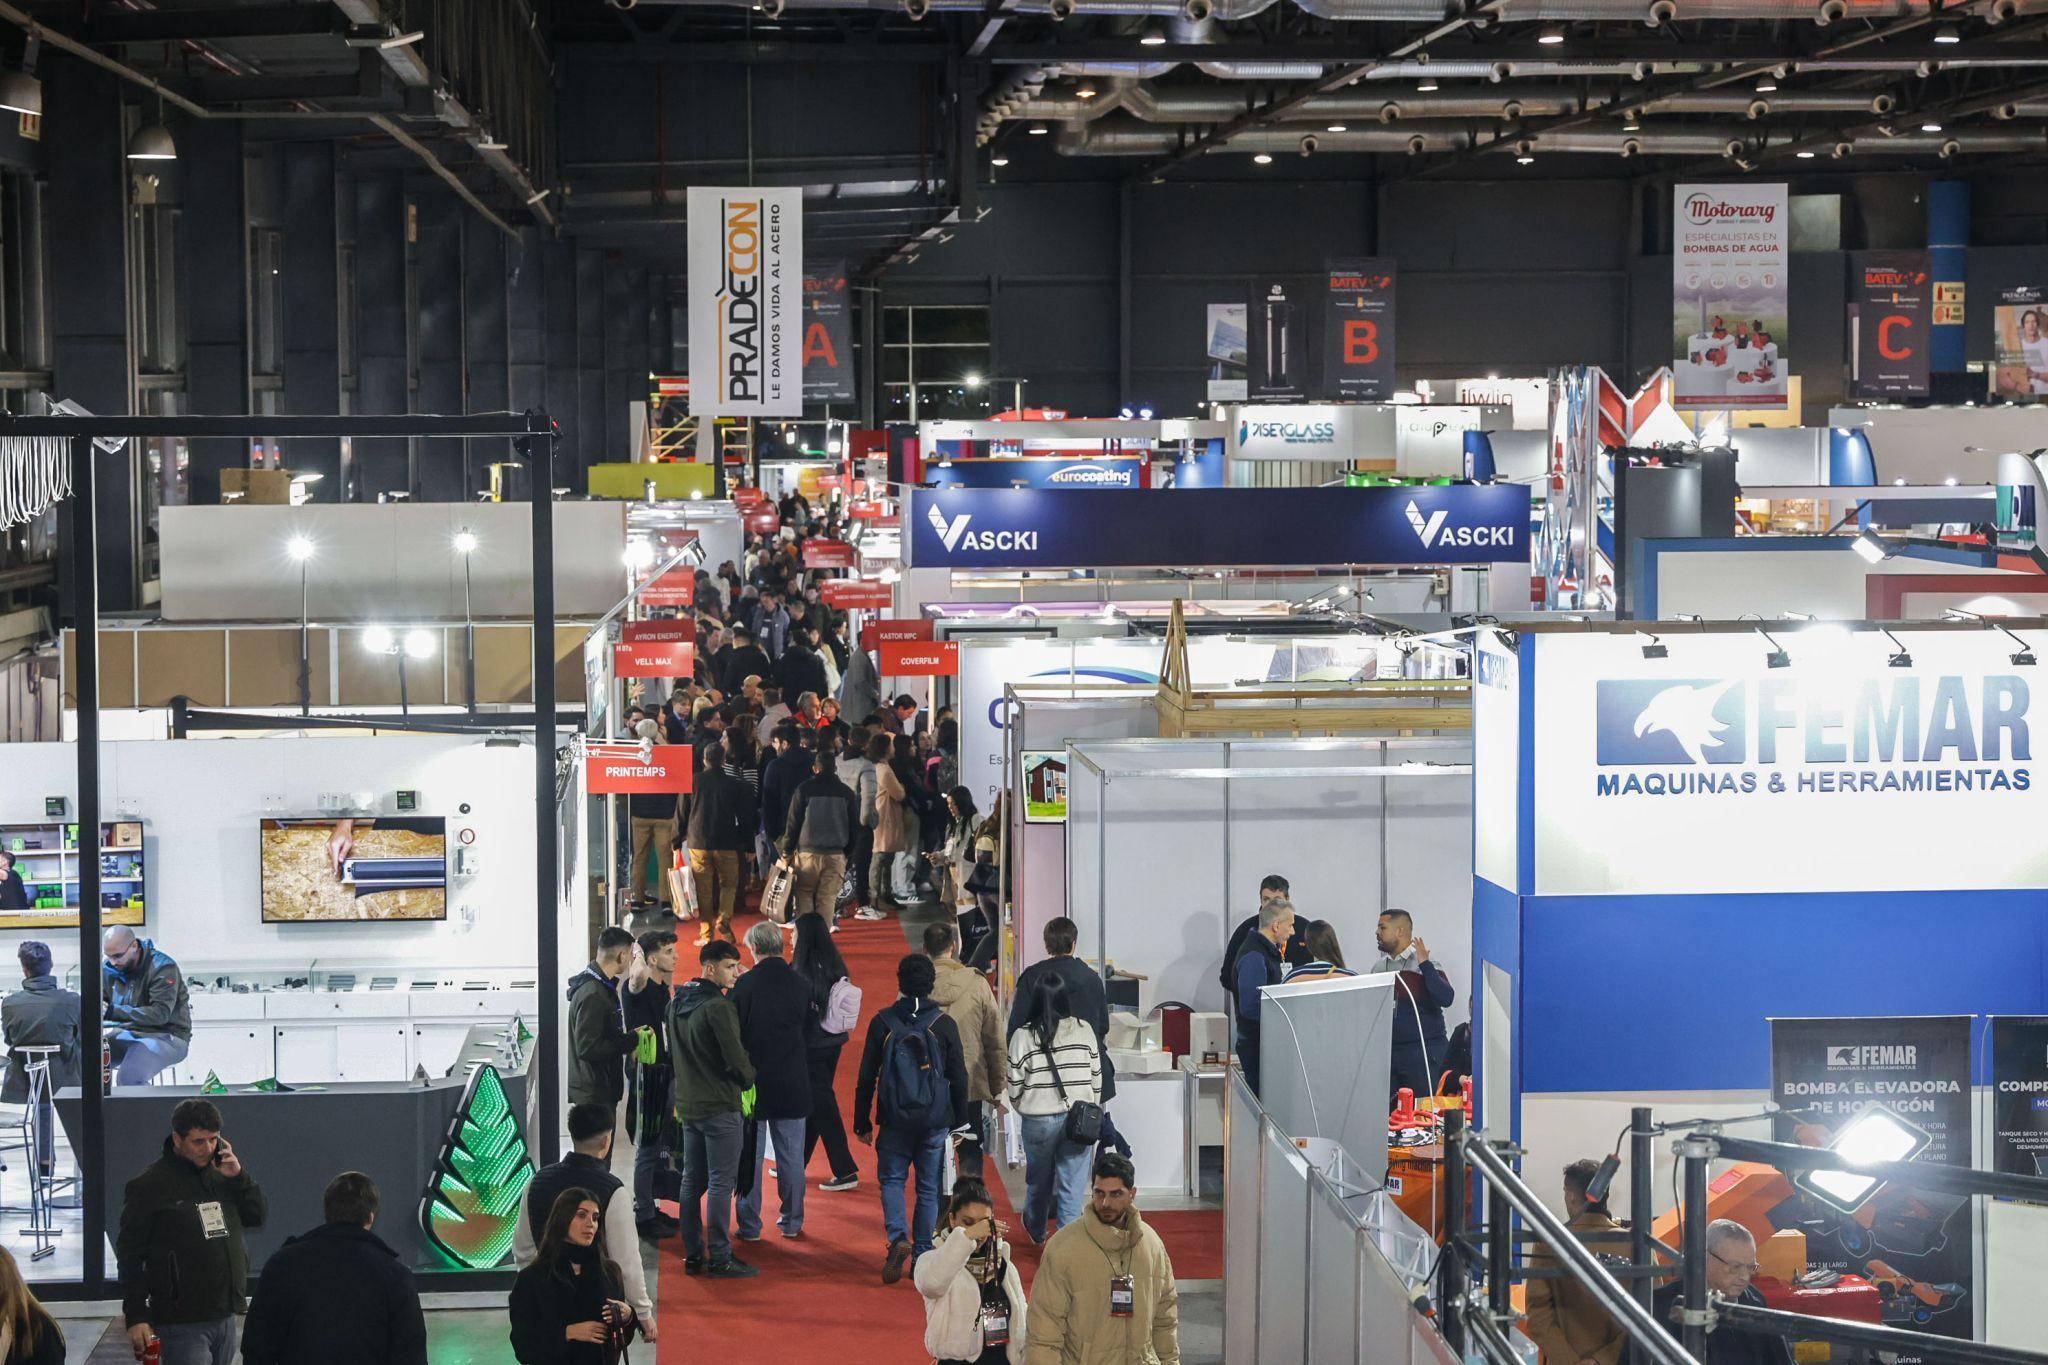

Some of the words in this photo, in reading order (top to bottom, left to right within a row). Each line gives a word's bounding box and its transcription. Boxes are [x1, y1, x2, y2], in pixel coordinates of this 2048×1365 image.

[1691, 200, 1775, 223] Motorarg
[771, 203, 780, 254] ACERO
[1685, 232, 1759, 242] ESPECIALISTAS
[1763, 232, 1777, 240] EN
[1683, 244, 1729, 253] BOMBAS
[1732, 244, 1746, 253] DE
[1749, 244, 1779, 252] AGUA
[771, 259, 780, 279] AL
[1865, 274, 1903, 284] BATEV
[1330, 277, 1368, 288] BATEV
[729, 202, 758, 401] PRADECON
[771, 284, 780, 319] VIDA
[802, 322, 838, 368] A
[1343, 320, 1379, 364] B
[1878, 315, 1912, 360] C
[771, 323, 780, 378] DAMOS
[771, 383, 780, 400] LE
[1052, 468, 1131, 486] eurocoating
[635, 658, 654, 666] VELL
[655, 657, 672, 665] MAX
[901, 657, 939, 665] COVERFILM
[1757, 675, 2033, 763] FEMAR
[605, 766, 666, 777] PRINTEMPS
[1597, 771, 1757, 796] MAQUINAS
[1767, 772, 1786, 792] &
[1798, 768, 2031, 793] HERRAMIENTAS
[1861, 1045, 1917, 1066] FEMAR
[1784, 1082, 1850, 1095] BOMBA
[1924, 1153, 1946, 1161] PLANO
